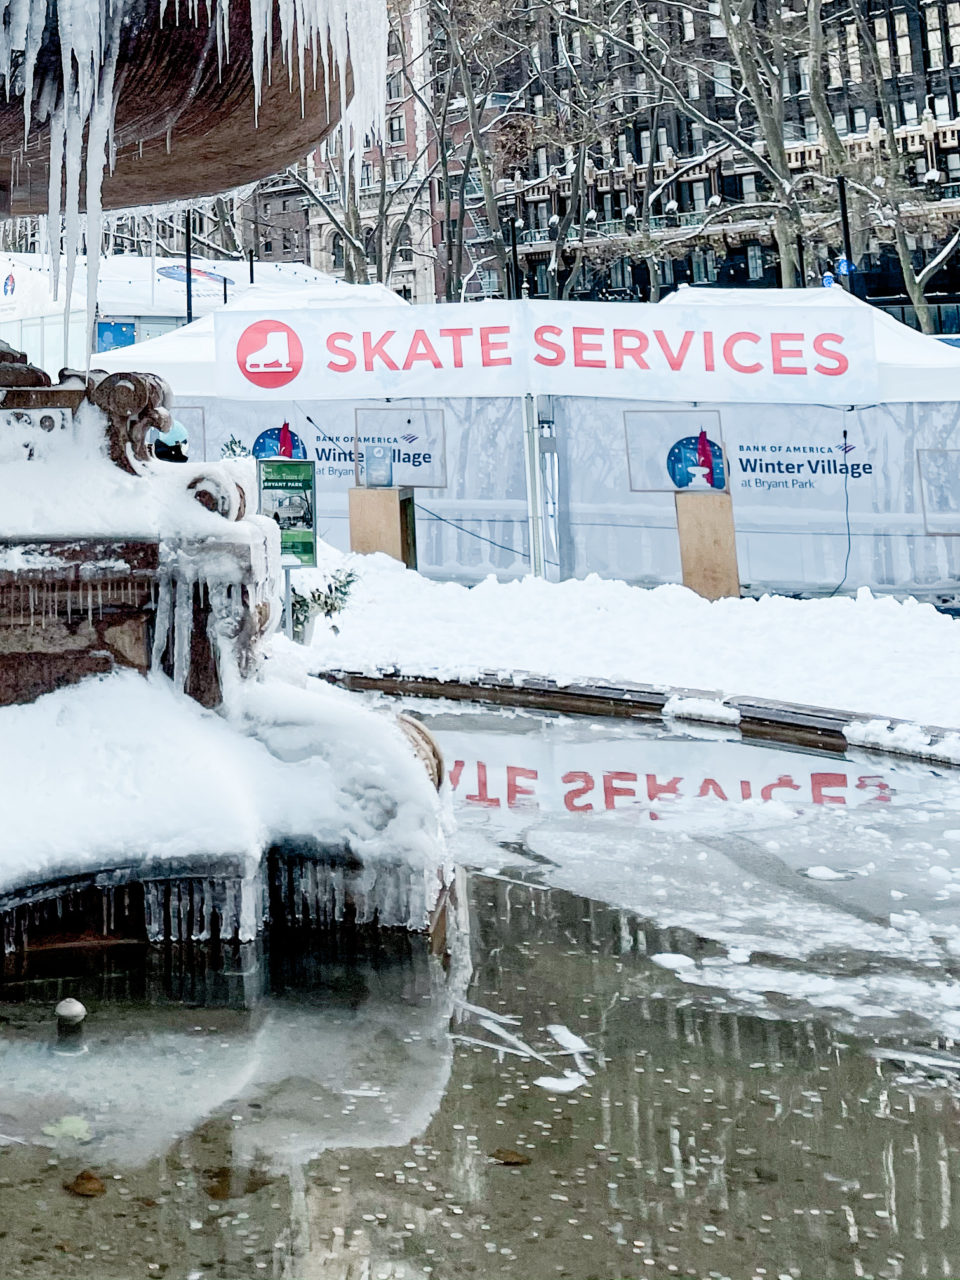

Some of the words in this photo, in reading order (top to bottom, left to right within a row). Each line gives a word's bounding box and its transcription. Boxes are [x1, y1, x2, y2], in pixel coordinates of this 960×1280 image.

[326, 326, 512, 373] SKATE
[533, 325, 849, 377] SERVICES
[357, 436, 398, 444] AMERICA
[785, 446, 833, 454] AMERICA
[315, 447, 365, 462] Winte
[392, 448, 432, 467] llage
[328, 466, 354, 478] Bryan
[738, 458, 804, 474] Winter
[807, 459, 872, 478] Village
[741, 480, 752, 488] at
[755, 478, 790, 490] Bryant
[791, 479, 815, 489] Park
